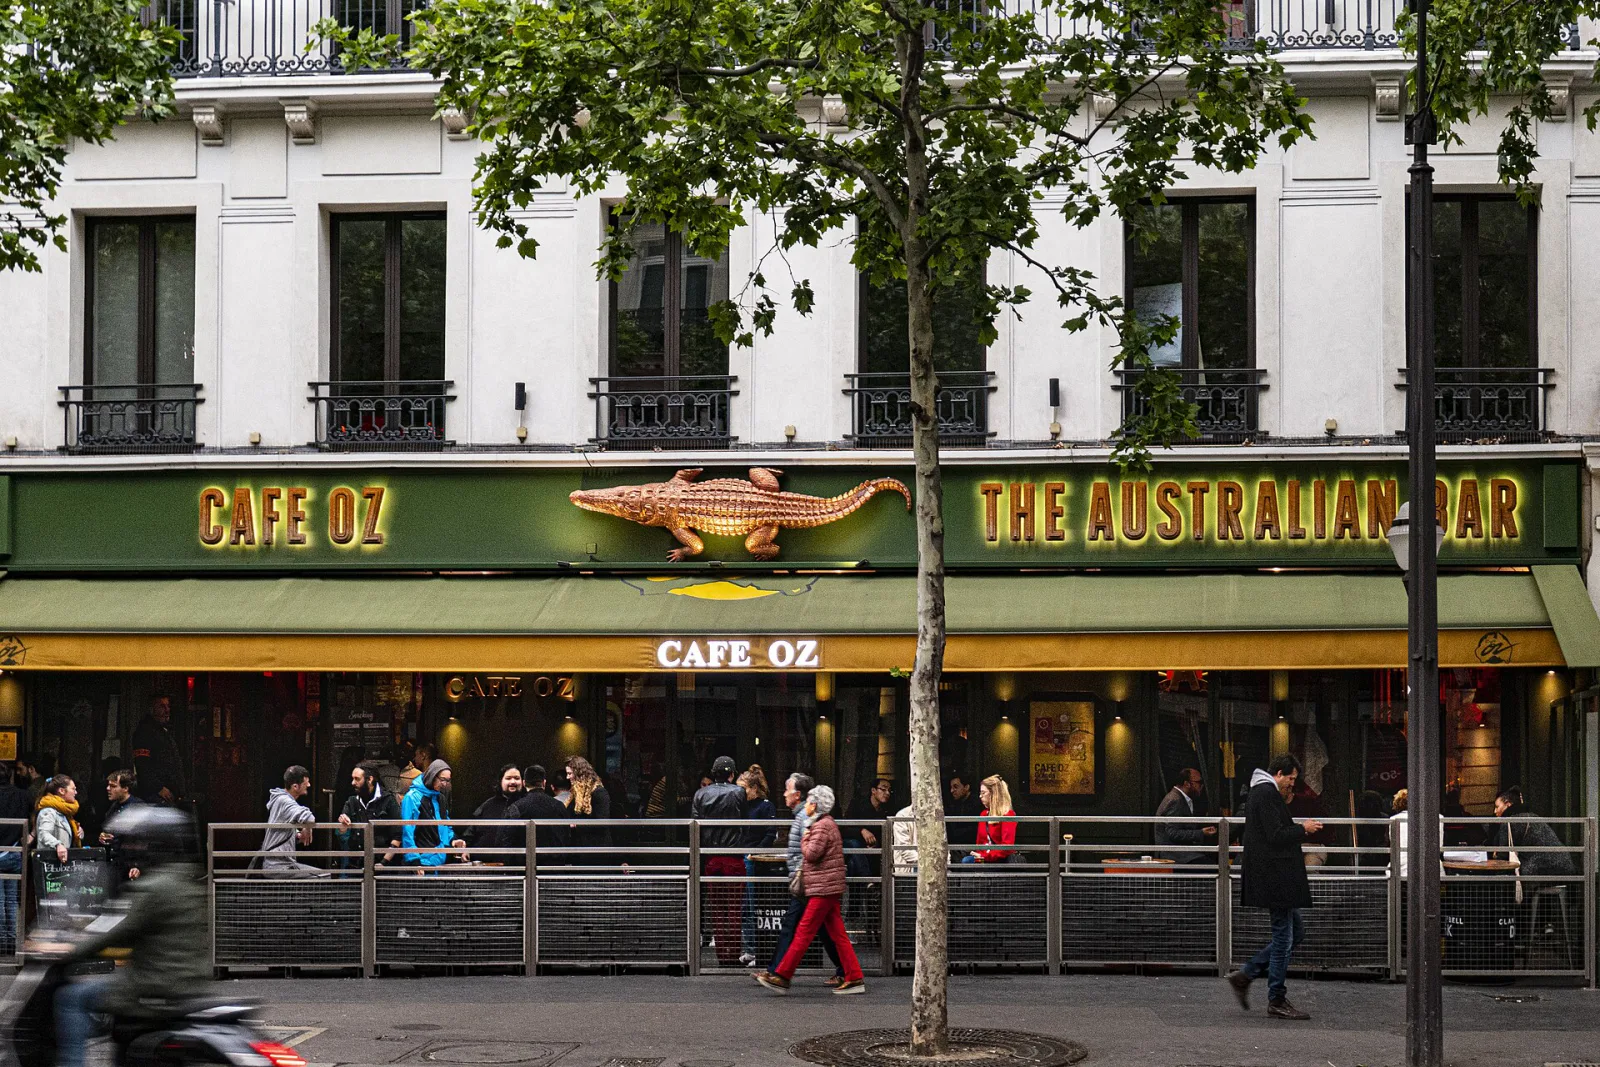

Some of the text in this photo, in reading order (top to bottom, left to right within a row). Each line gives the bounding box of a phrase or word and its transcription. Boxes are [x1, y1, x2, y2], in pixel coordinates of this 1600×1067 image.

[199, 486, 386, 545] CAFE OZ
[980, 482, 1066, 541] THE
[1088, 479, 1397, 541] AUSTRALIAN
[656, 639, 819, 667] CAFE OZ
[445, 675, 576, 698] CAFE OZ
[1034, 763, 1069, 772] CAFE OZ
